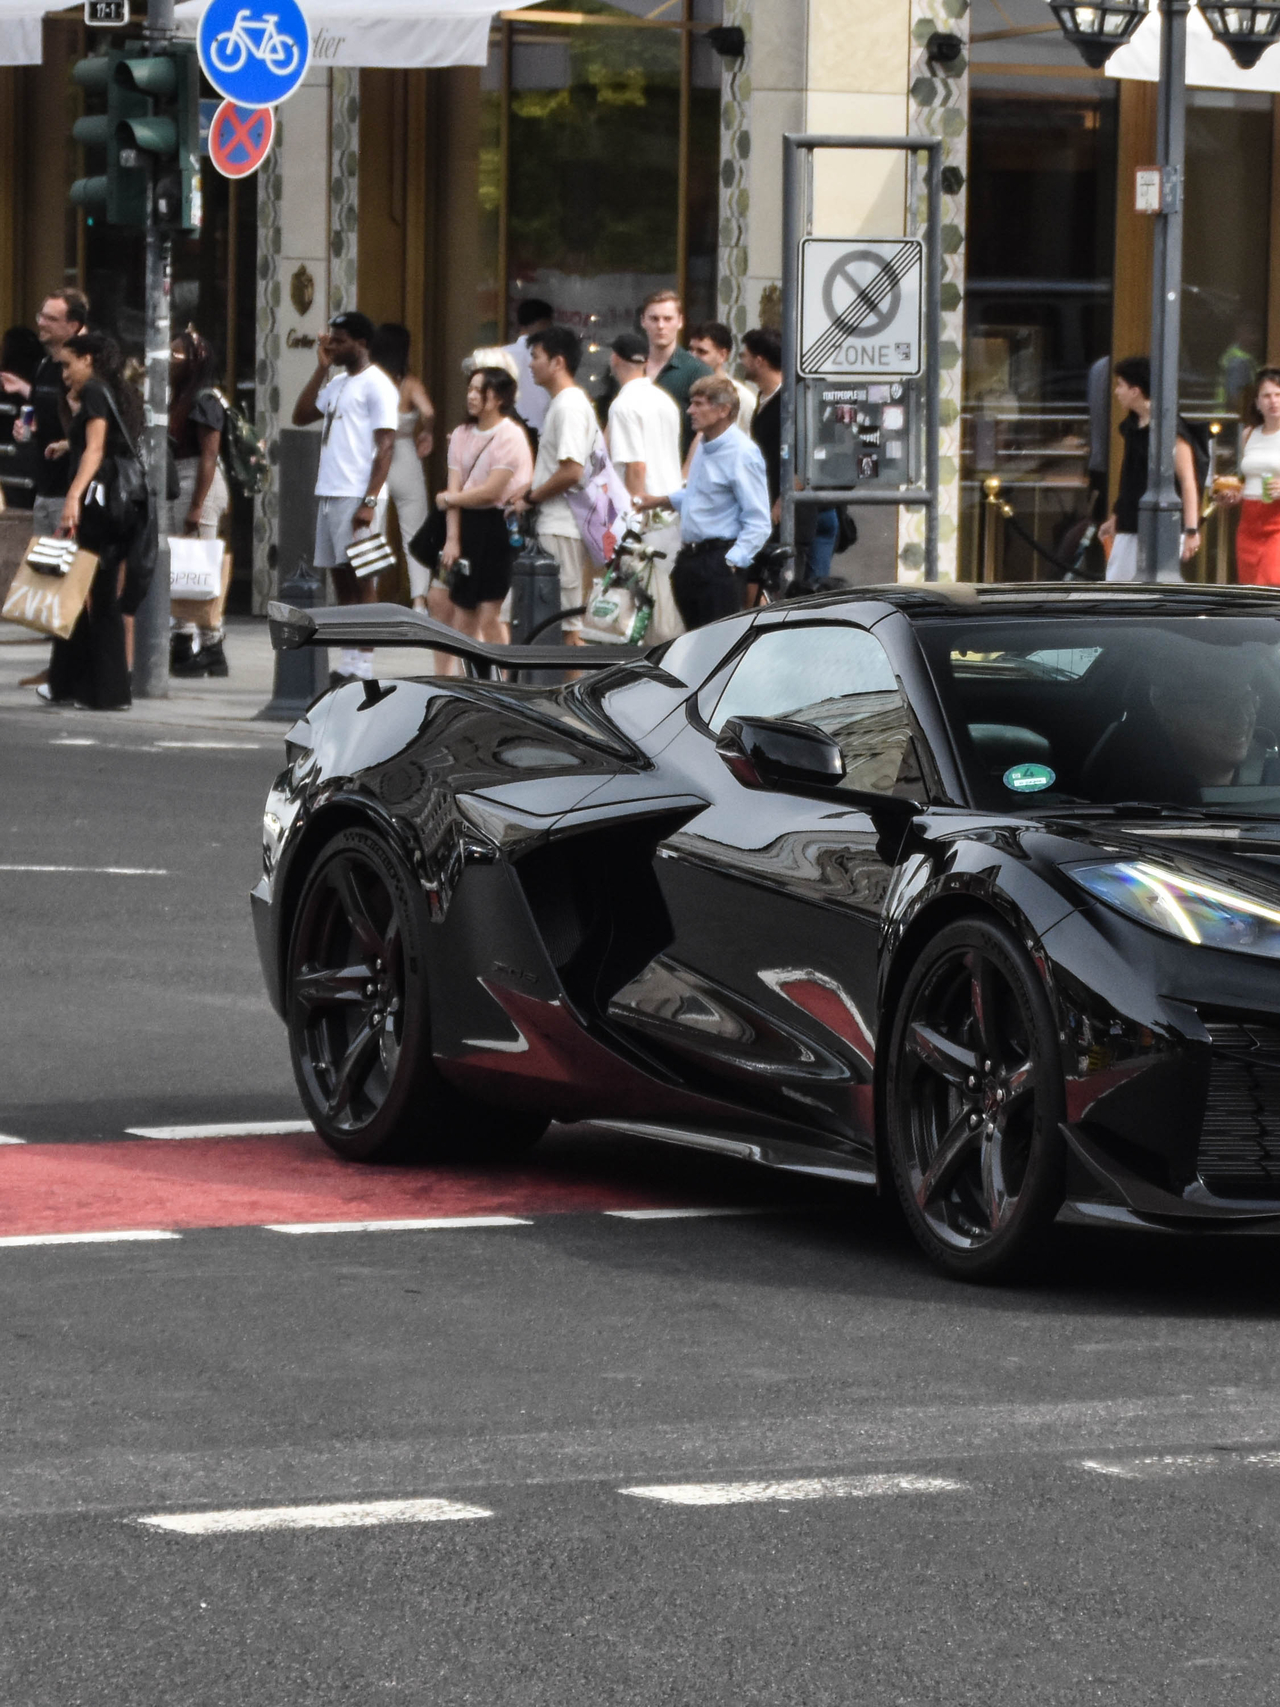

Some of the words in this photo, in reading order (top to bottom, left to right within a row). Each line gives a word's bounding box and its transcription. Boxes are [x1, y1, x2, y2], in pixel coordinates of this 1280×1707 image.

[312, 27, 345, 58] tier
[831, 345, 891, 366] ZONE
[169, 572, 211, 586] SPRIT
